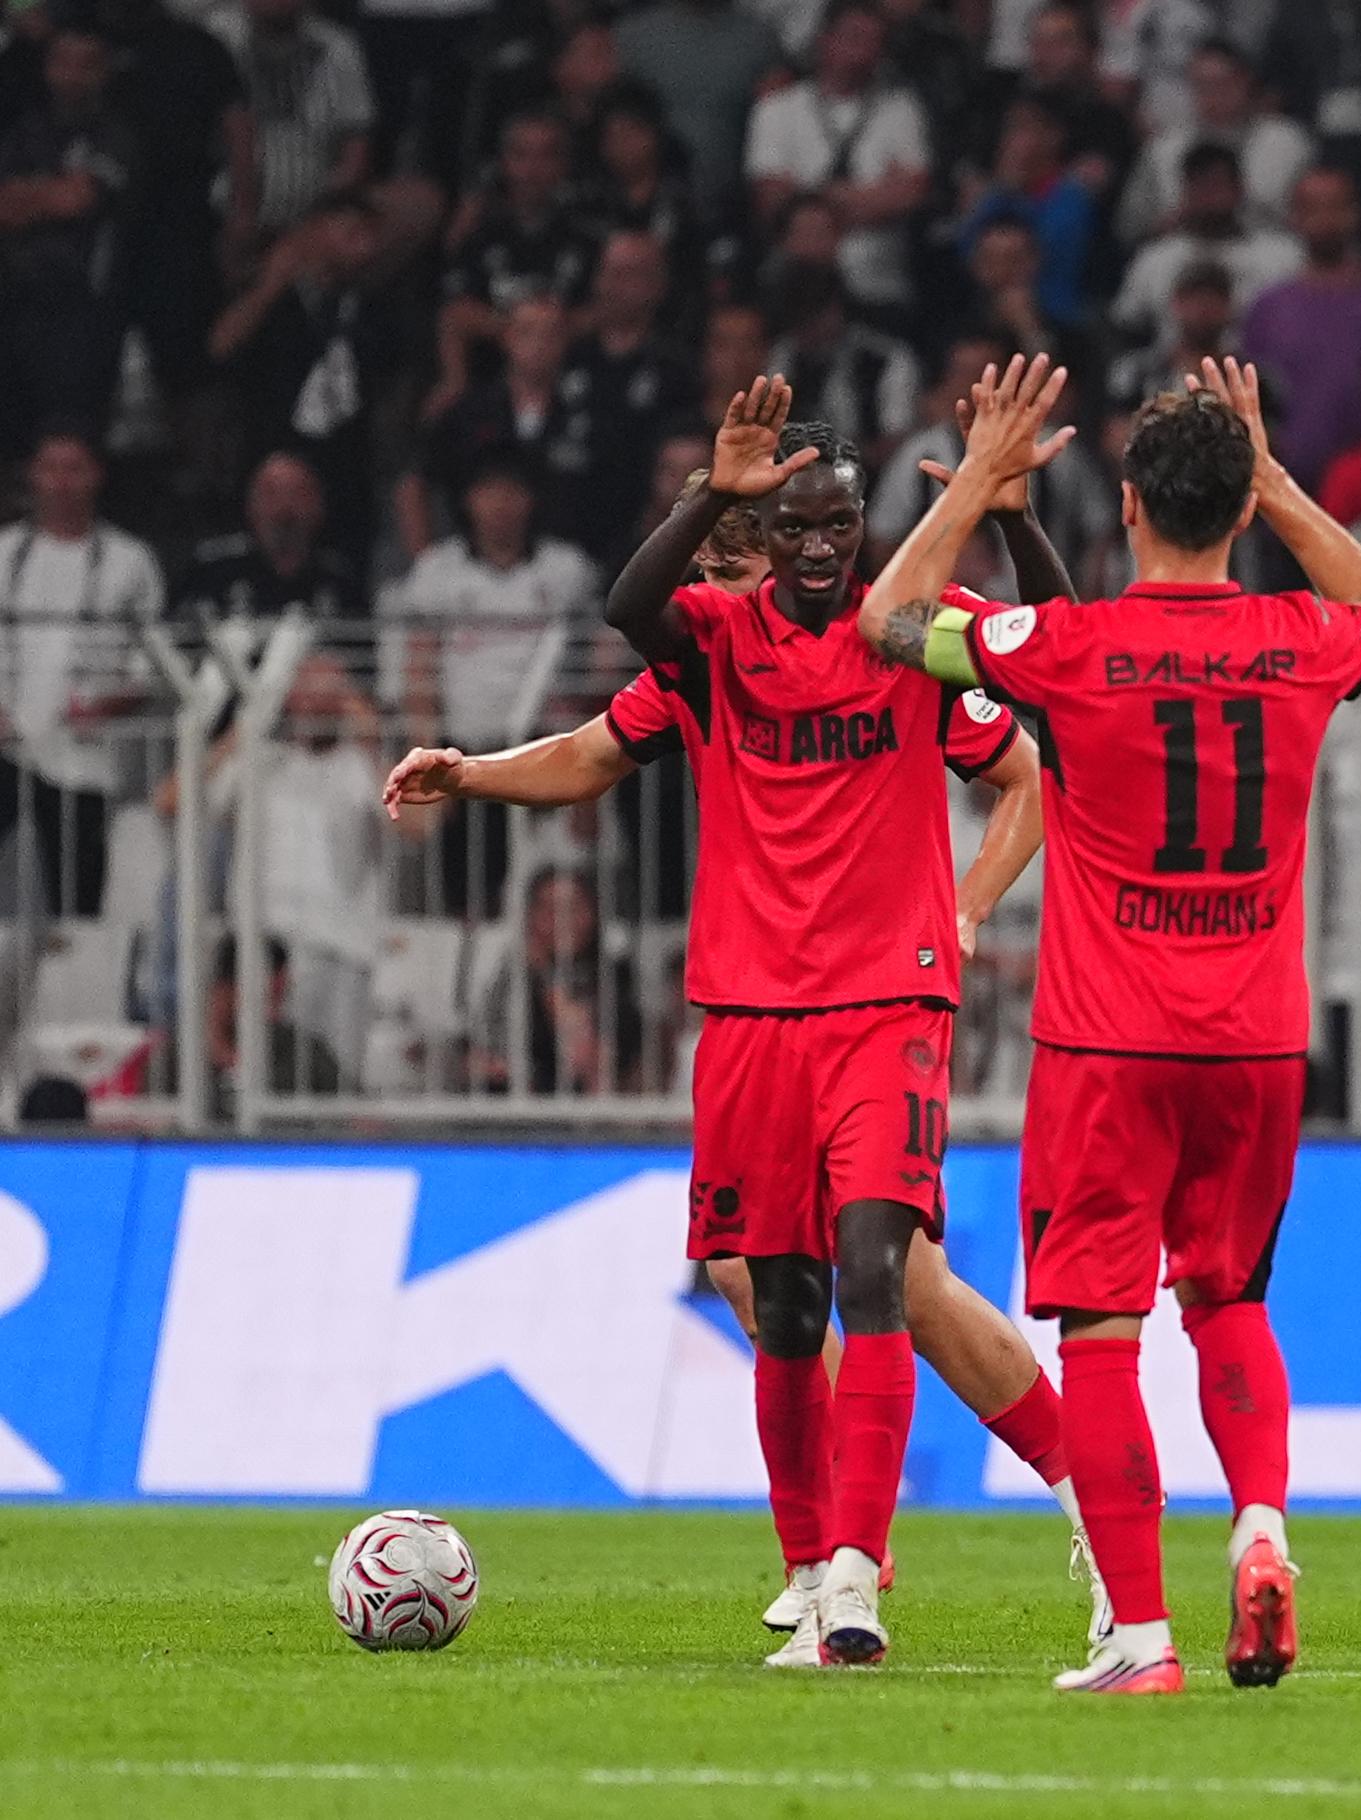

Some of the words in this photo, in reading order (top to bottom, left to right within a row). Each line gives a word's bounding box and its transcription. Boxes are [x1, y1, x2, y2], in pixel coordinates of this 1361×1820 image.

[1105, 649, 1297, 685] BALKAR
[790, 706, 898, 764] ARCA
[1154, 697, 1269, 873] 11
[904, 1090, 947, 1166] 10
